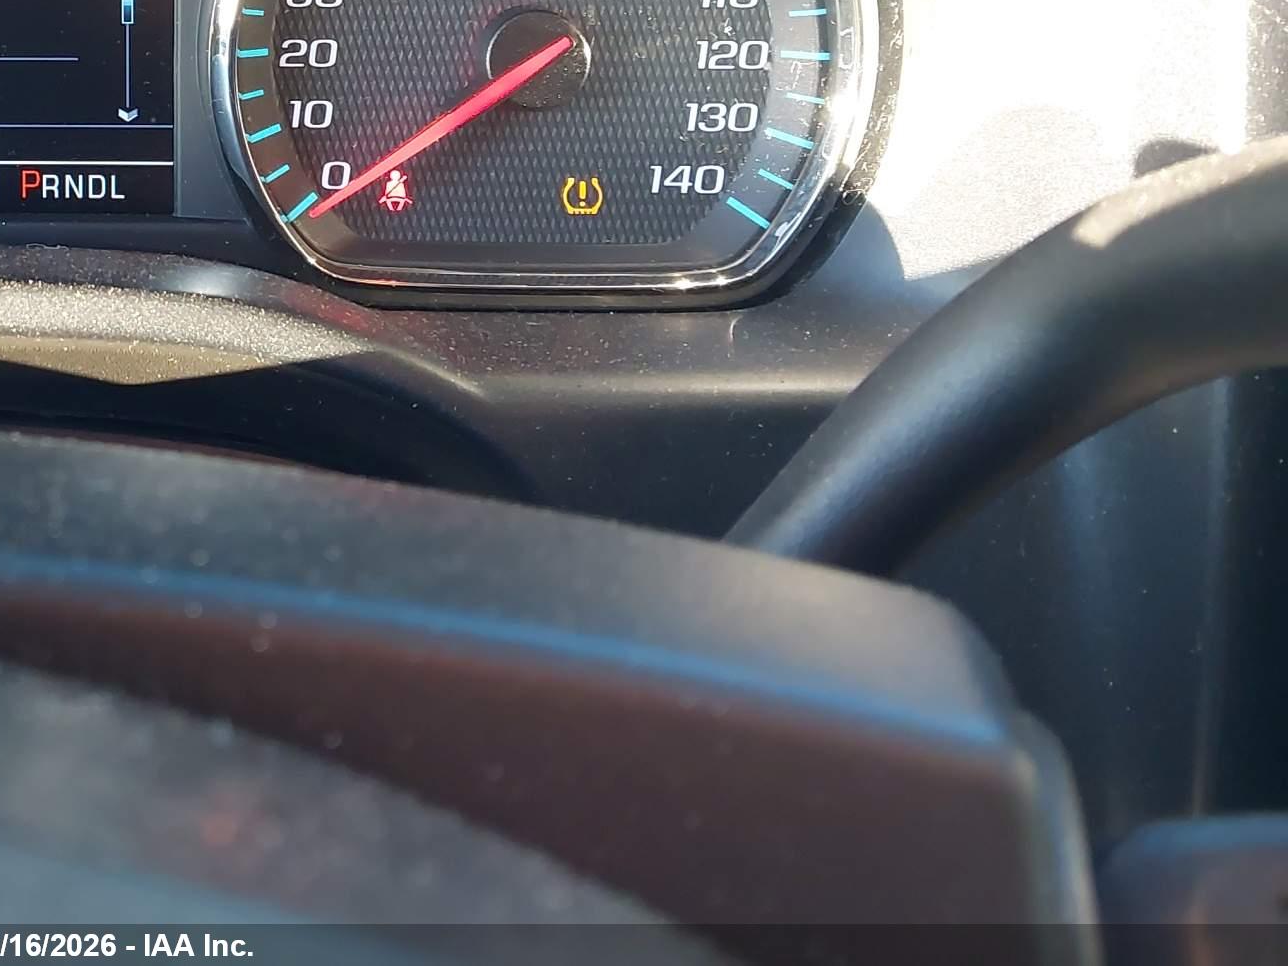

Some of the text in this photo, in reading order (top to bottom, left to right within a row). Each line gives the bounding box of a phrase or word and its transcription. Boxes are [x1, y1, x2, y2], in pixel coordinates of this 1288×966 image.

[278, 39, 338, 67] 20
[696, 40, 769, 69] 120
[289, 100, 333, 129] 10
[686, 102, 759, 132] 130
[321, 161, 352, 190] 0
[650, 164, 725, 194] 140
